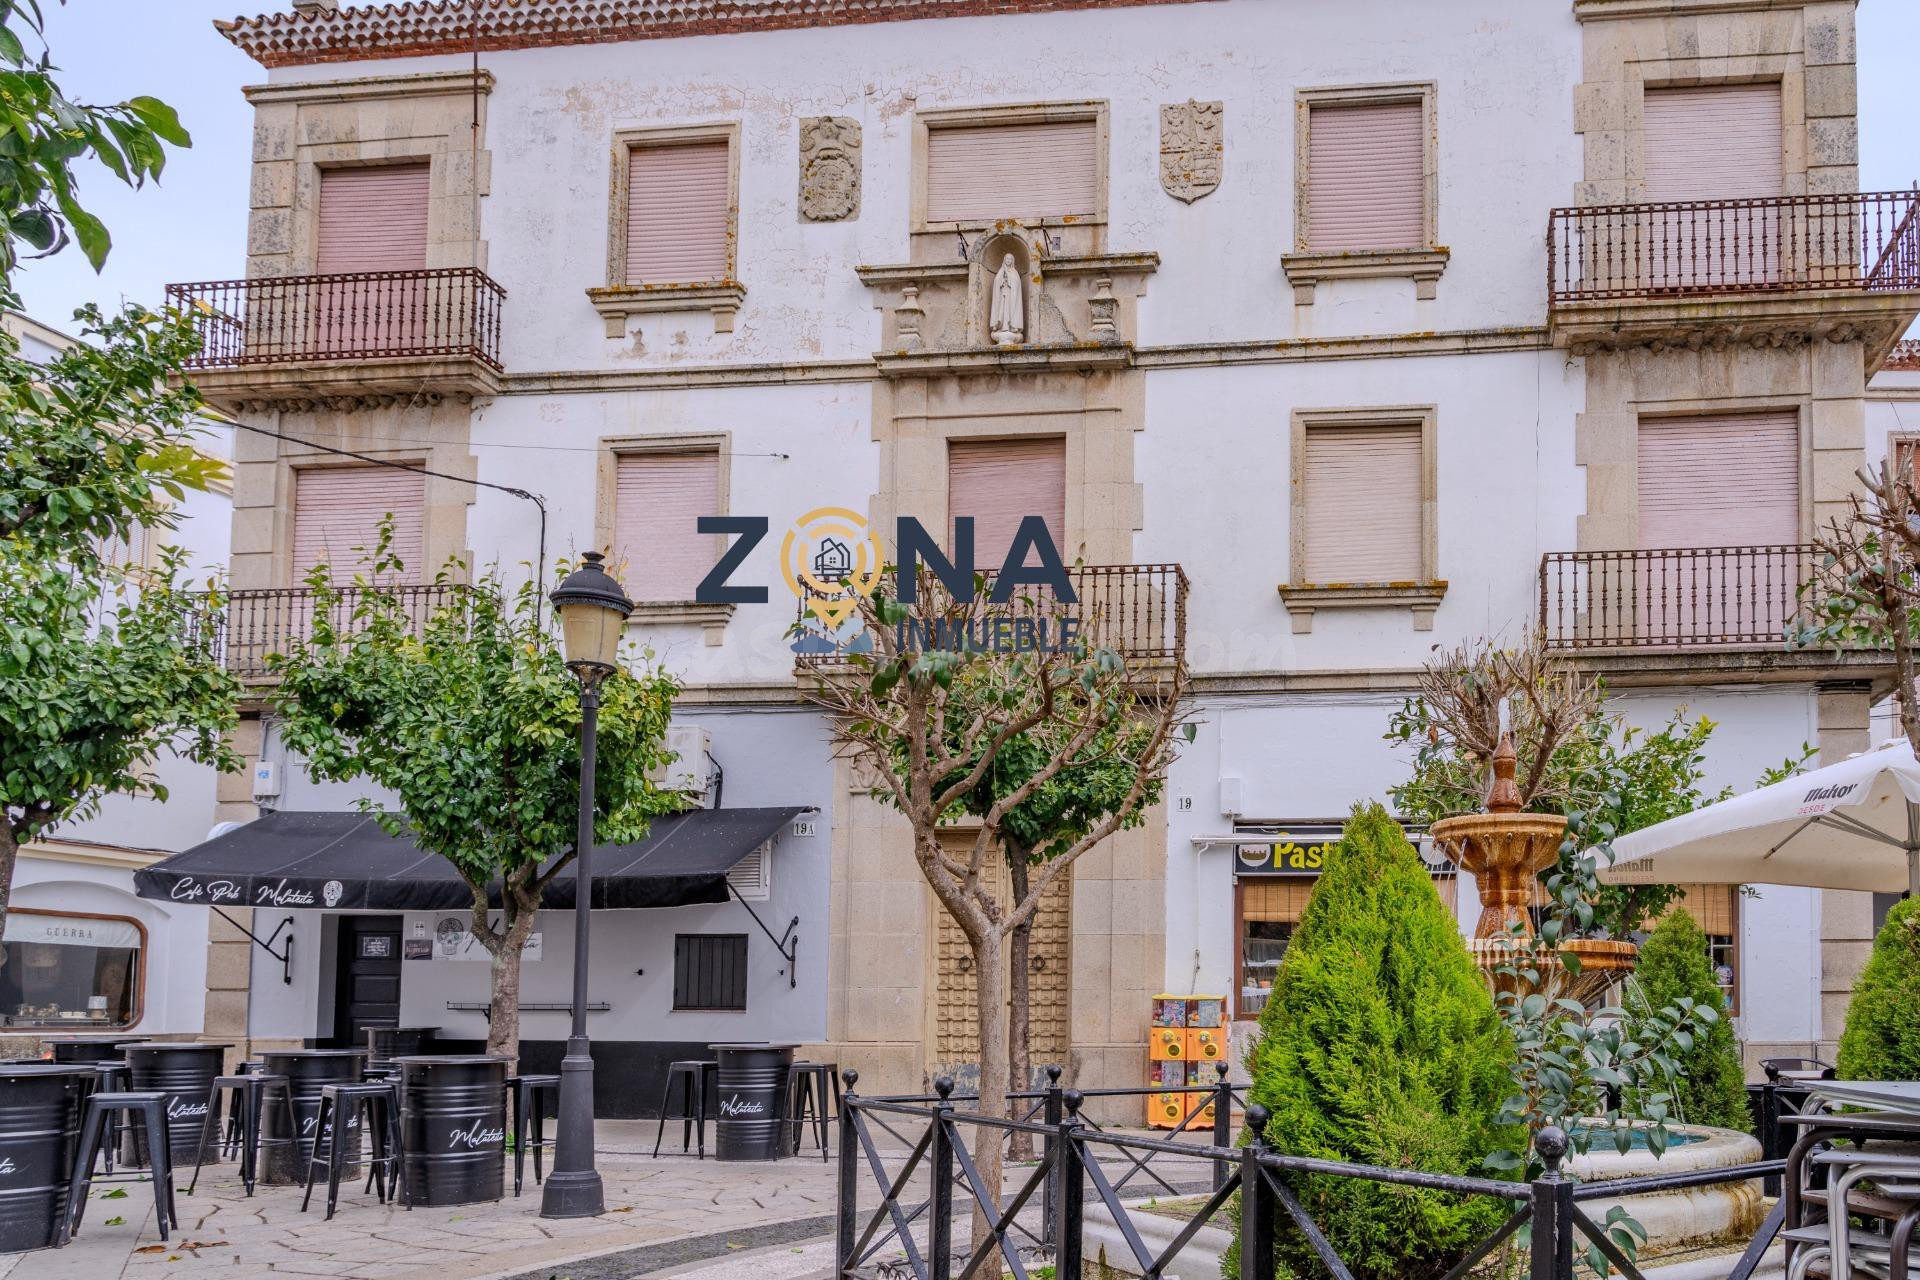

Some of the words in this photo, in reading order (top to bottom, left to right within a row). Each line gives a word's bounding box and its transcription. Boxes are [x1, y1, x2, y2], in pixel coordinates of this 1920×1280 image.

[1179, 797, 1192, 810] 19
[1273, 831, 1331, 869] Past
[171, 877, 203, 900] Café
[206, 880, 241, 902] Pub
[256, 878, 315, 906] Malatesta
[46, 927, 94, 939] GUERRA
[720, 1093, 764, 1117] Malatesta
[449, 1118, 504, 1148] Malatesta
